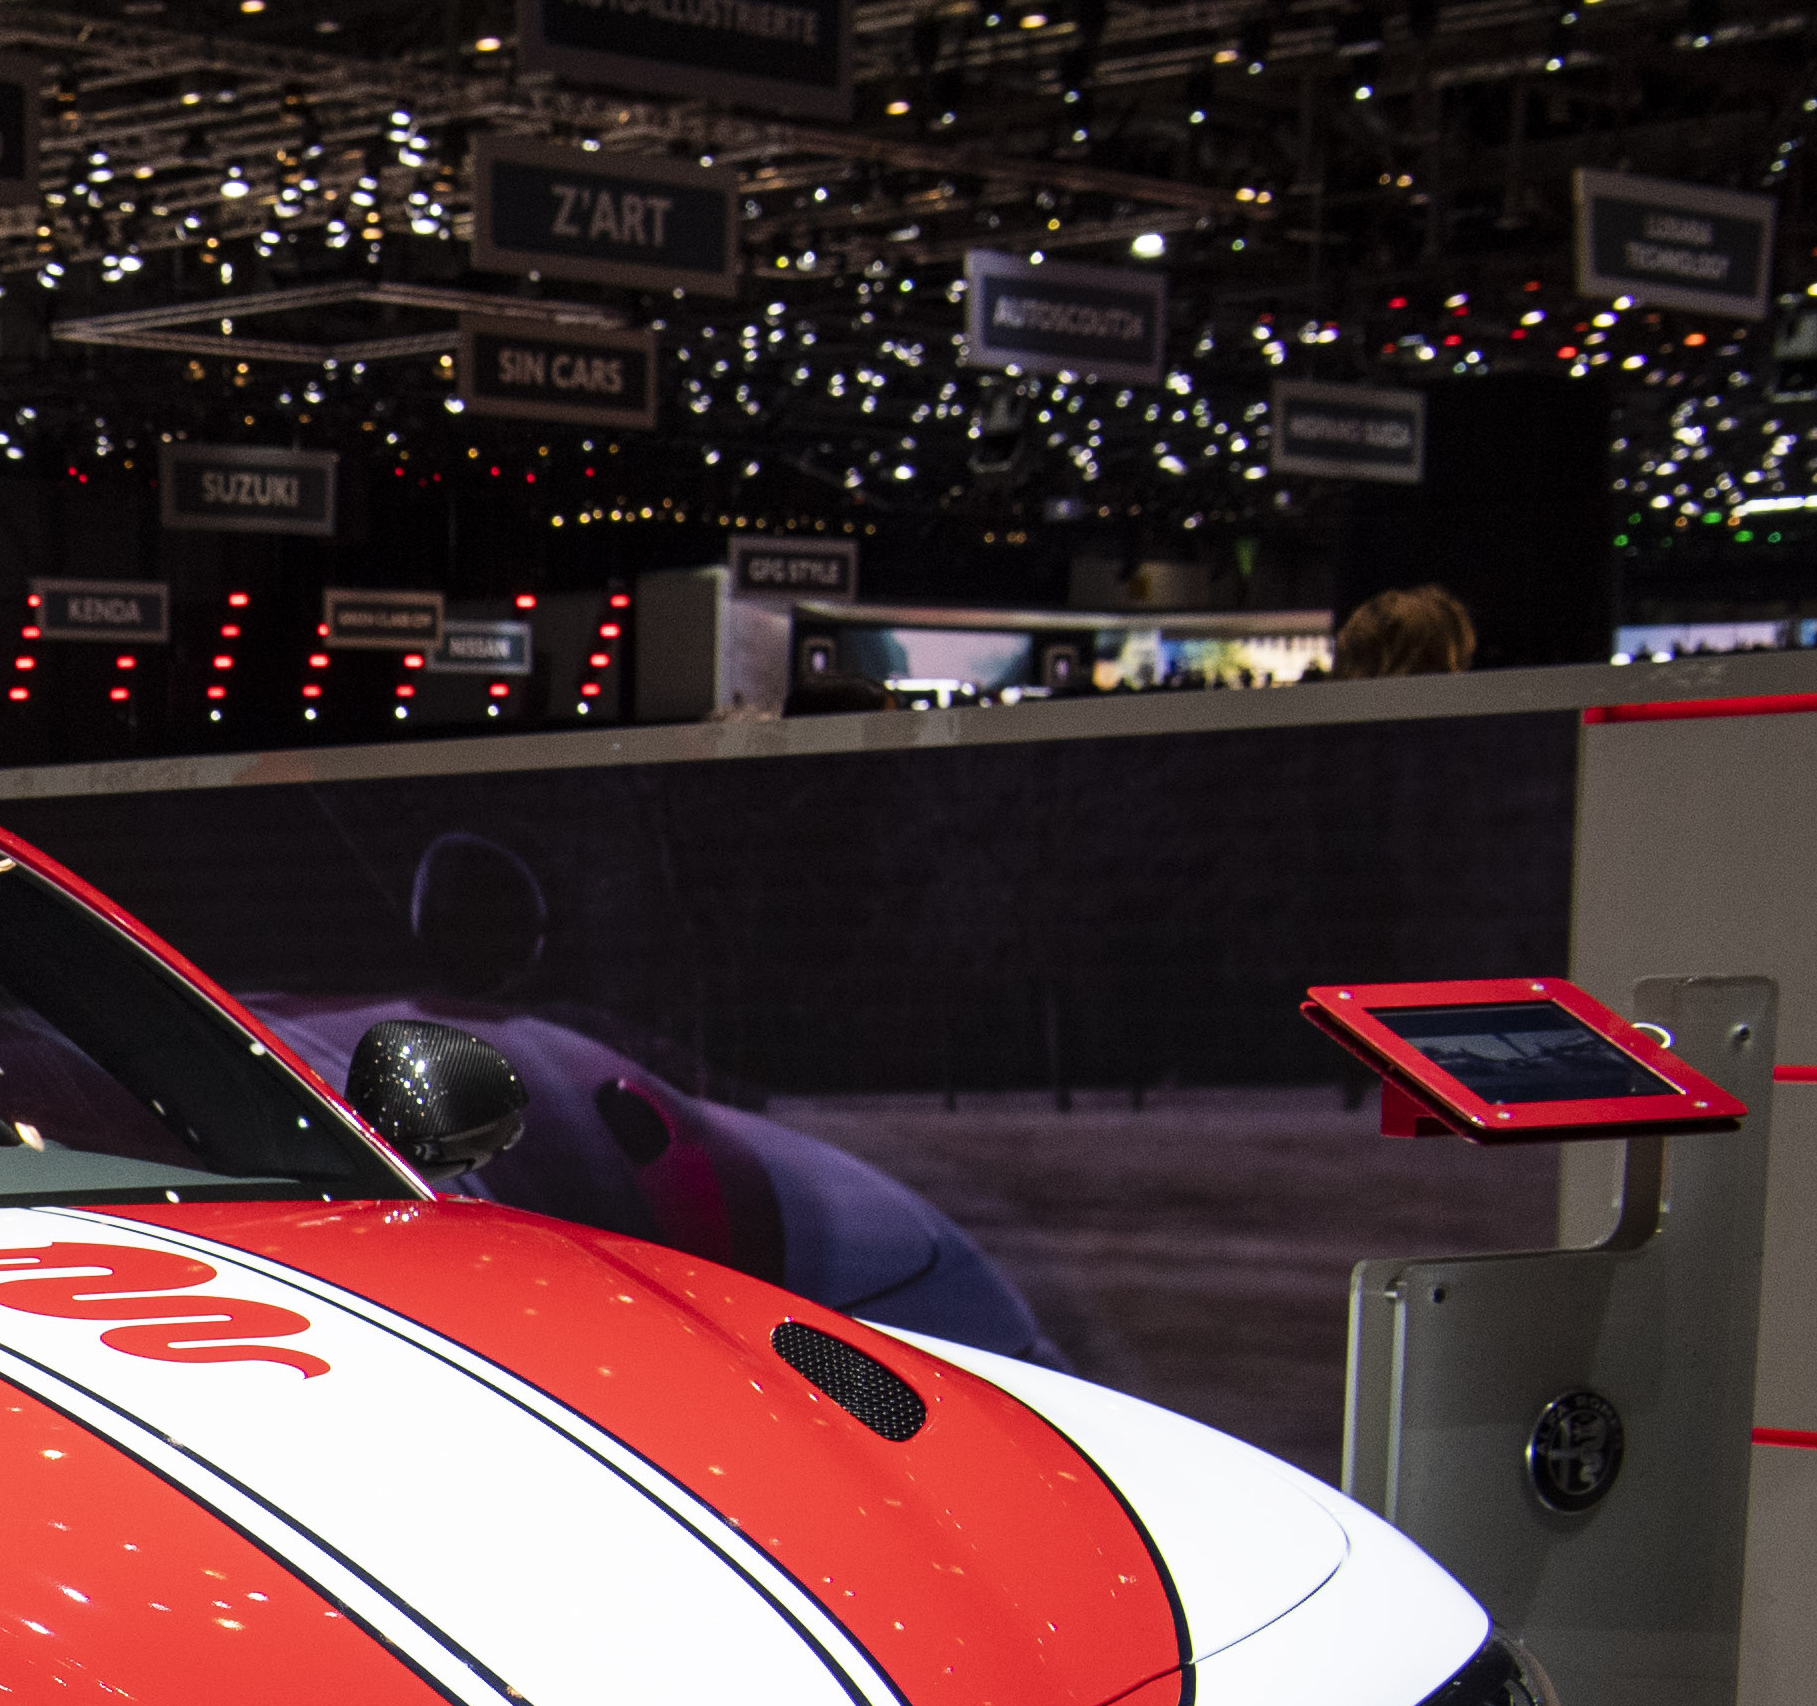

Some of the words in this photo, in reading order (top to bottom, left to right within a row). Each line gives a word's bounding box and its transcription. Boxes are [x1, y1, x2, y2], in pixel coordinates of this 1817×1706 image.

[550, 183, 673, 249] Z'ART
[498, 347, 546, 388] SIN
[550, 353, 623, 395] CARS
[201, 472, 299, 508] SUZUKI
[69, 597, 141, 624] KENDA
